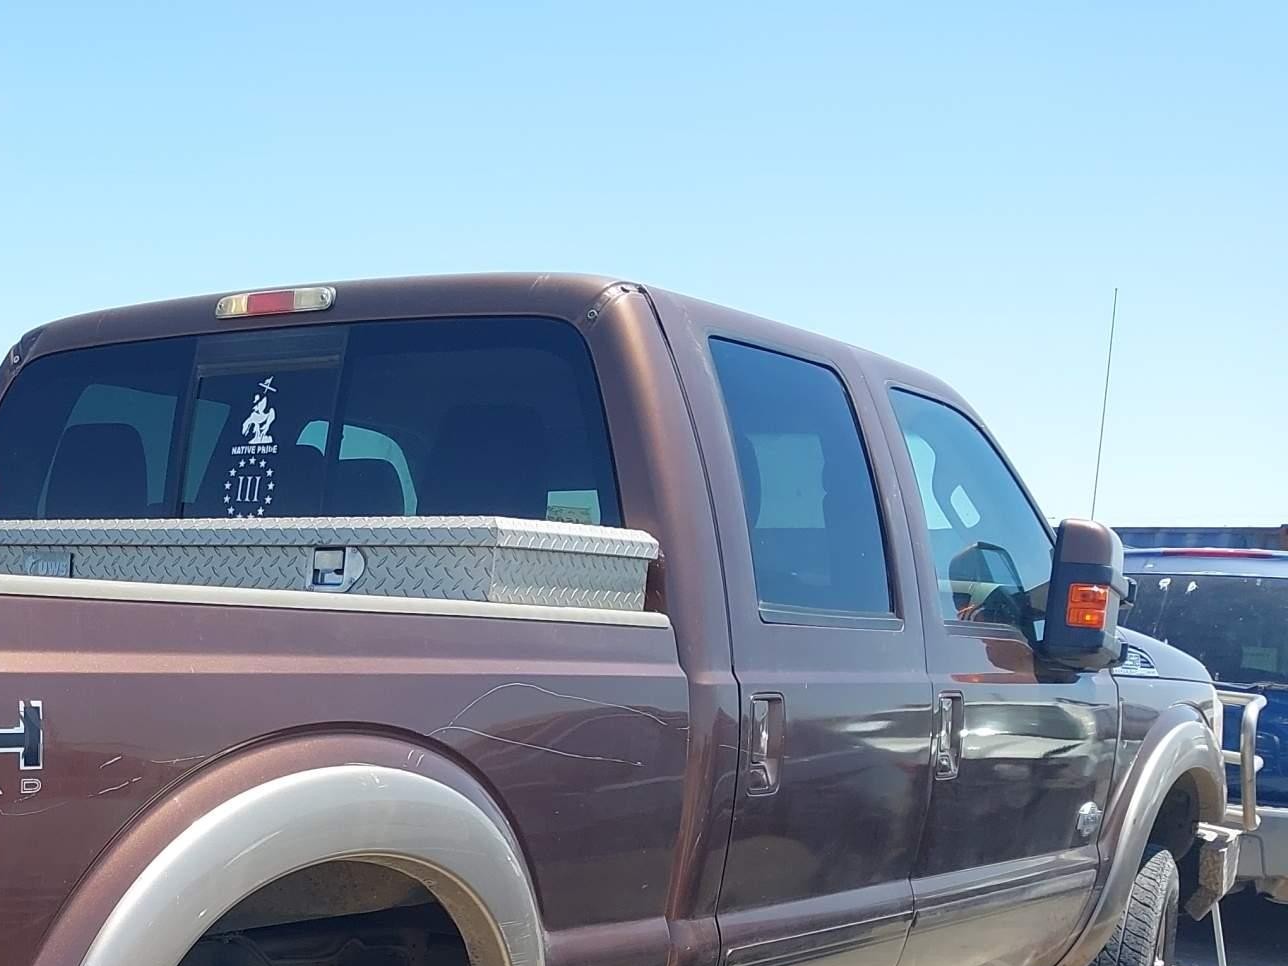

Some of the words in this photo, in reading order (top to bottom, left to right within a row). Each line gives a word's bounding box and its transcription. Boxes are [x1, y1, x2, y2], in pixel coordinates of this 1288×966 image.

[232, 445, 256, 455] NATIVE
[257, 445, 278, 454] PRIDE
[236, 476, 261, 502] III
